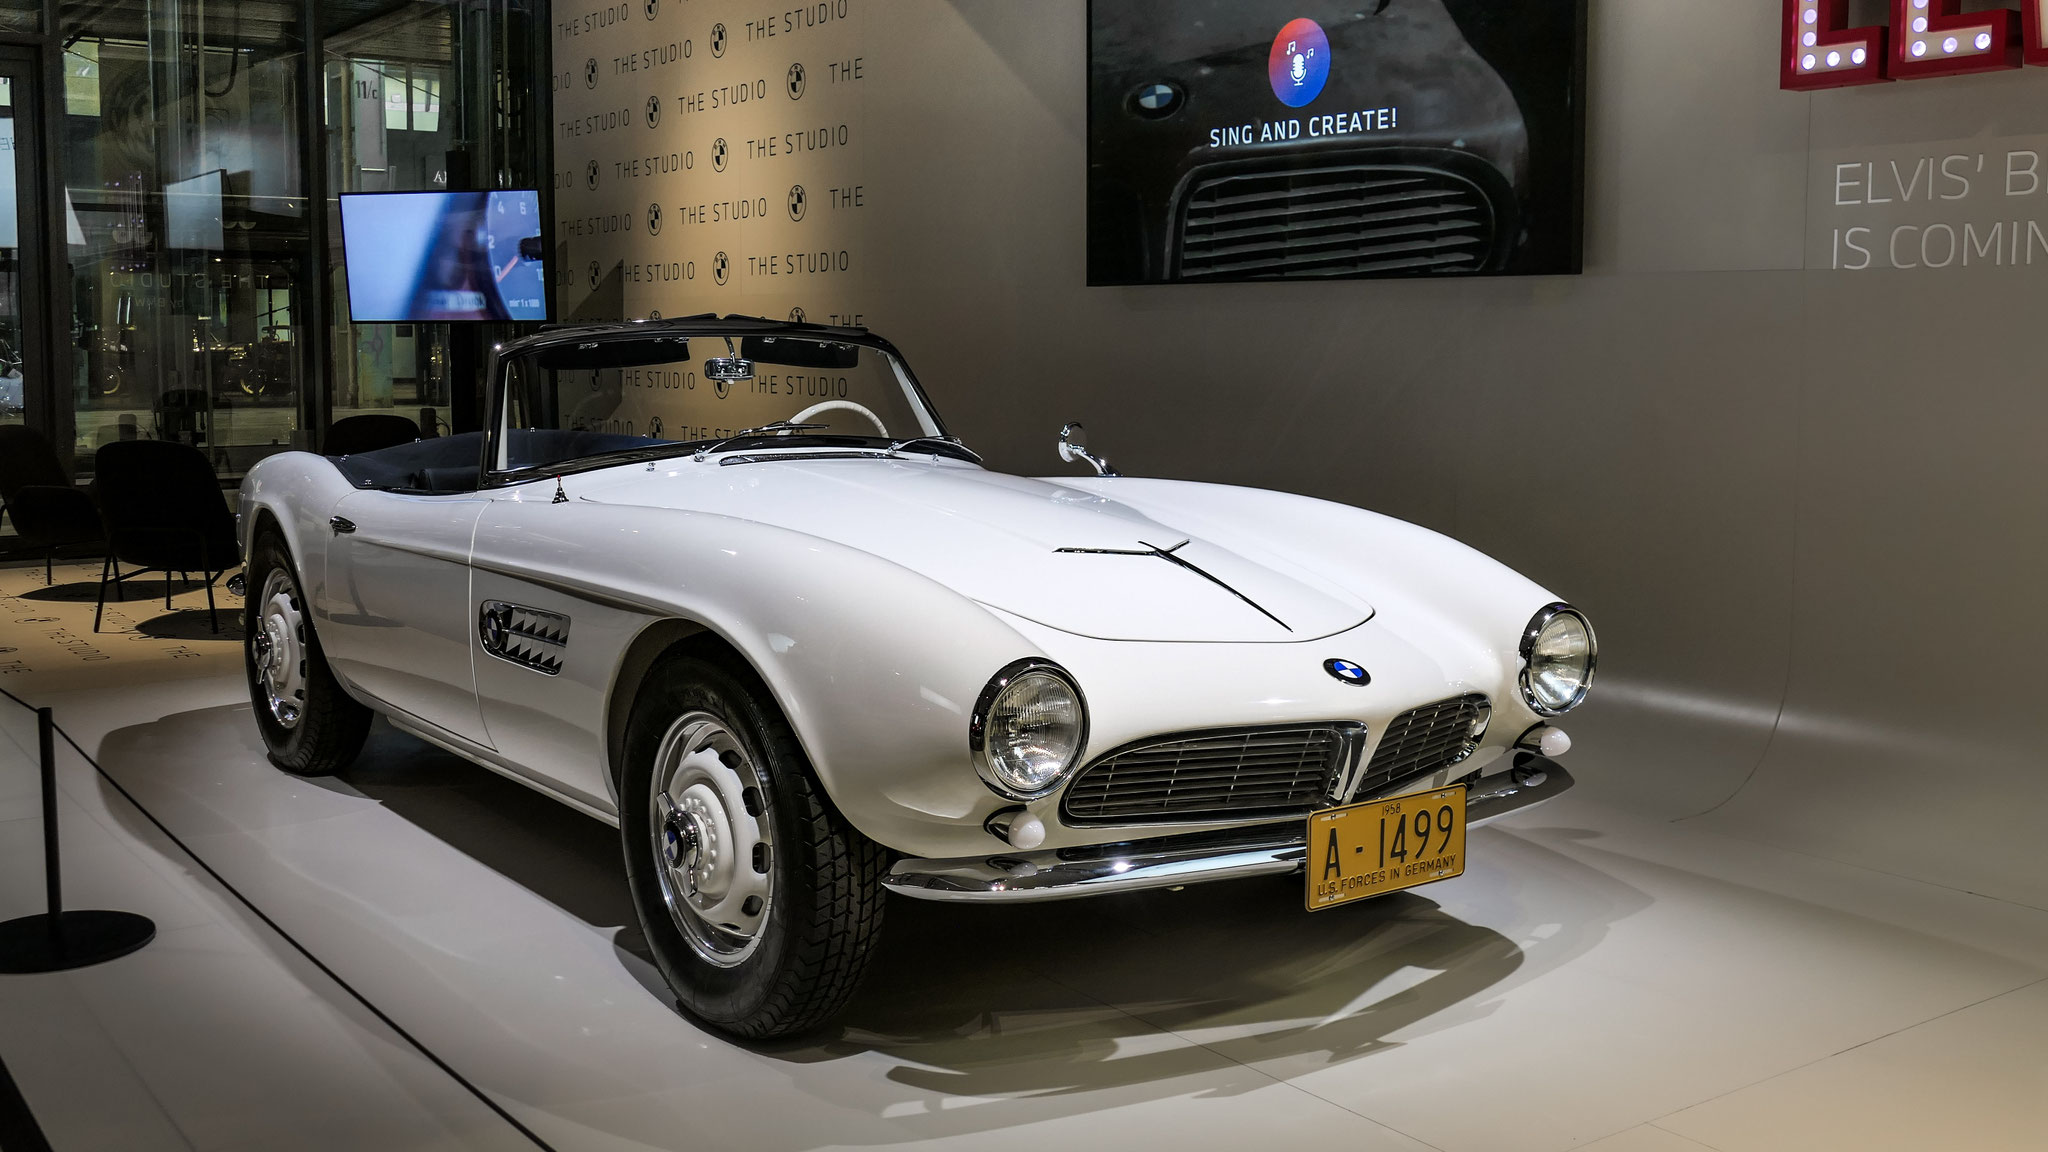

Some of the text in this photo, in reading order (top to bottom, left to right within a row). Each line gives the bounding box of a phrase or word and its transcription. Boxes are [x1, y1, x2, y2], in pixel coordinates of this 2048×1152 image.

[558, 3, 629, 40] THE STUDIO
[746, 0, 847, 42] THE STUDIO
[613, 39, 692, 75] THE STUDIO
[829, 57, 863, 84] THE
[678, 79, 766, 115] THE STUDIO
[560, 108, 630, 139] THE STUDIO
[1210, 107, 1397, 148] SING AND CREATE!
[747, 124, 848, 159] THE STUDIO
[615, 151, 694, 180] THE STUDIO
[680, 197, 767, 225] THE STUDIO
[829, 186, 863, 209] THE
[561, 219, 583, 237] THE
[588, 213, 632, 235] STUDIO
[748, 250, 849, 276] THE STUDIO
[1832, 227, 1871, 270] IS
[617, 261, 695, 283] THE STUDIO
[618, 369, 696, 390] THE STUDIO
[750, 375, 848, 398] THE STUDIO
[1382, 802, 1401, 816] 1958
[1317, 853, 1457, 897] U.S. FORCES IN GERMANY
